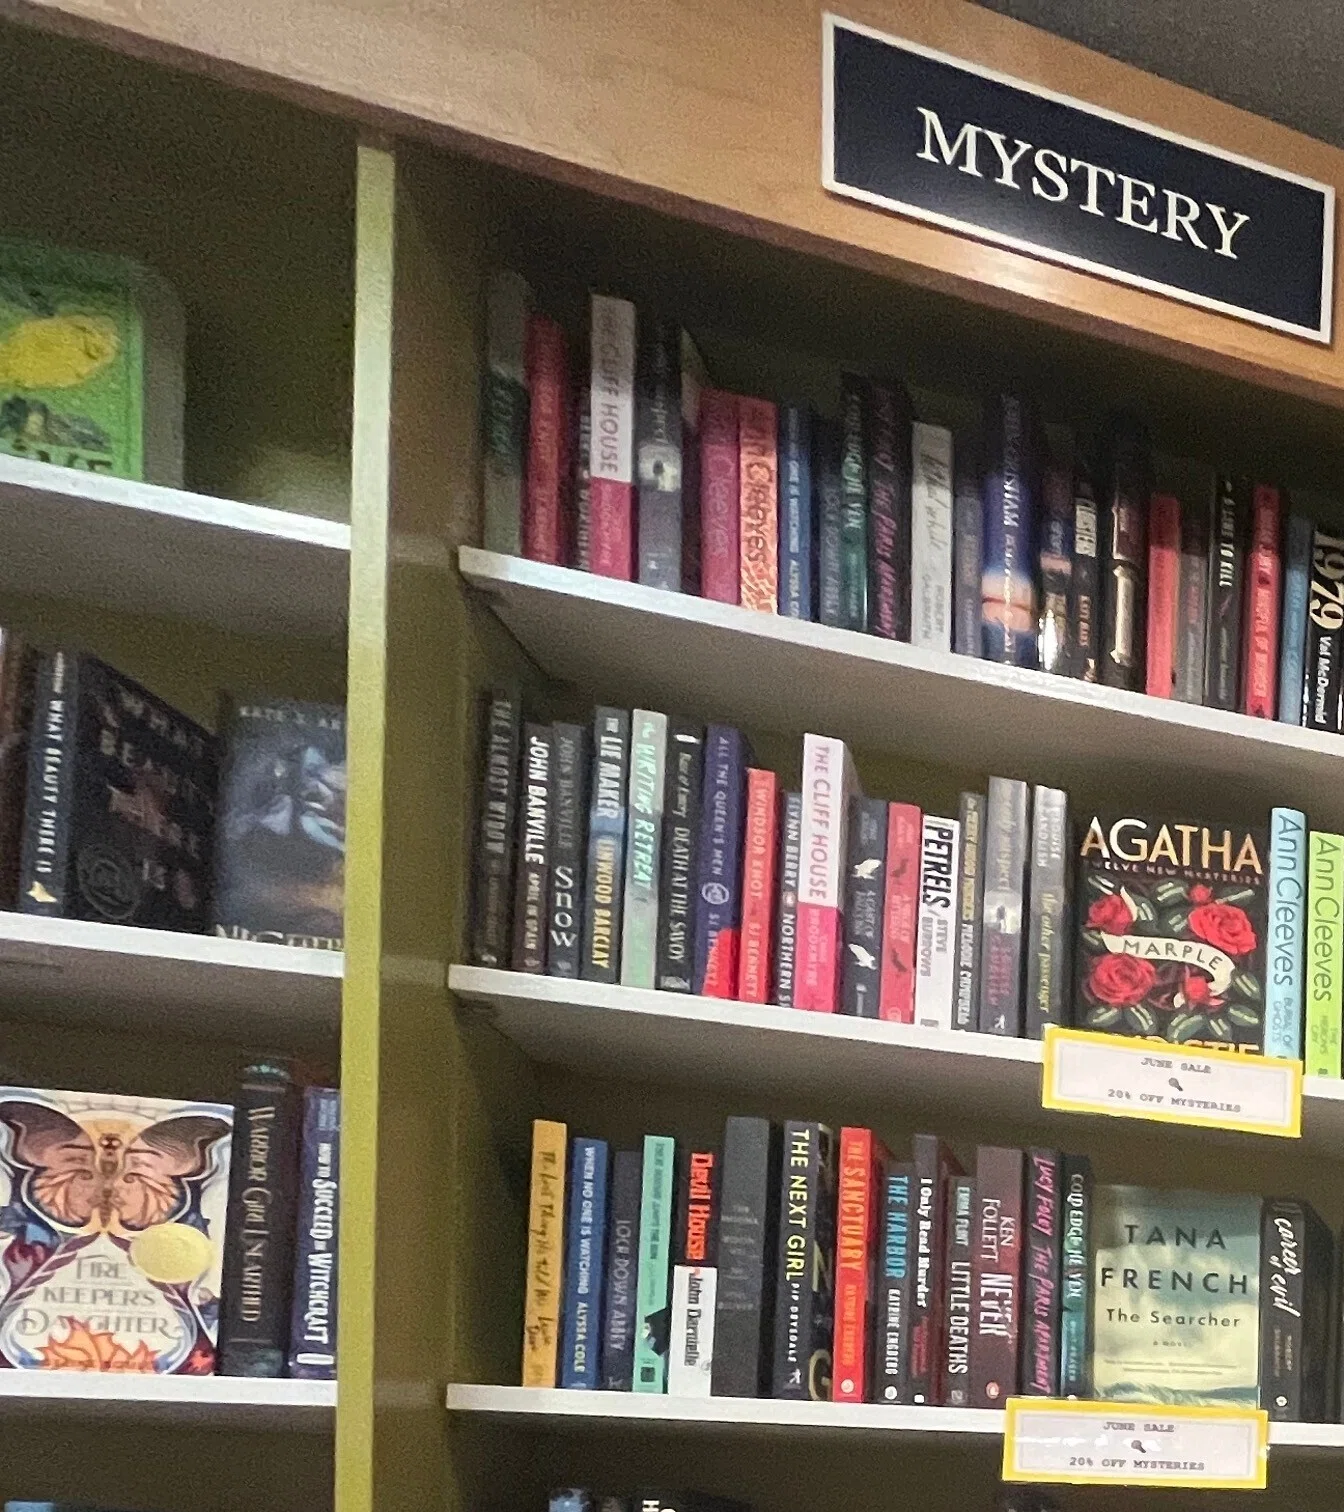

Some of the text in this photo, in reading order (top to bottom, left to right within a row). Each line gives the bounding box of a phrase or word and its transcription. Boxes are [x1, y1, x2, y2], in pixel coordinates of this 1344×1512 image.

[916, 107, 1252, 260] MYSTERY
[1320, 637, 1333, 653] Val
[1312, 654, 1331, 726] McDermid
[524, 736, 550, 866] JOHN BANVILLE
[806, 745, 831, 900] THE CLIFF HOUSE
[1082, 816, 1264, 874] AGATHA
[1270, 813, 1304, 988] Ann Cleeves
[1123, 936, 1223, 971] MARPLE
[784, 1128, 809, 1282] THE NEXT GIRL
[1124, 1224, 1228, 1250] TANA
[76, 1254, 128, 1280] FIRE
[1100, 1266, 1250, 1295] FRENCH
[1106, 1309, 1241, 1328] The Searcher
[1103, 1421, 1175, 1433] JUNE SALE
[1070, 1456, 1205, 1472] 20% OFF MYSTERIES
